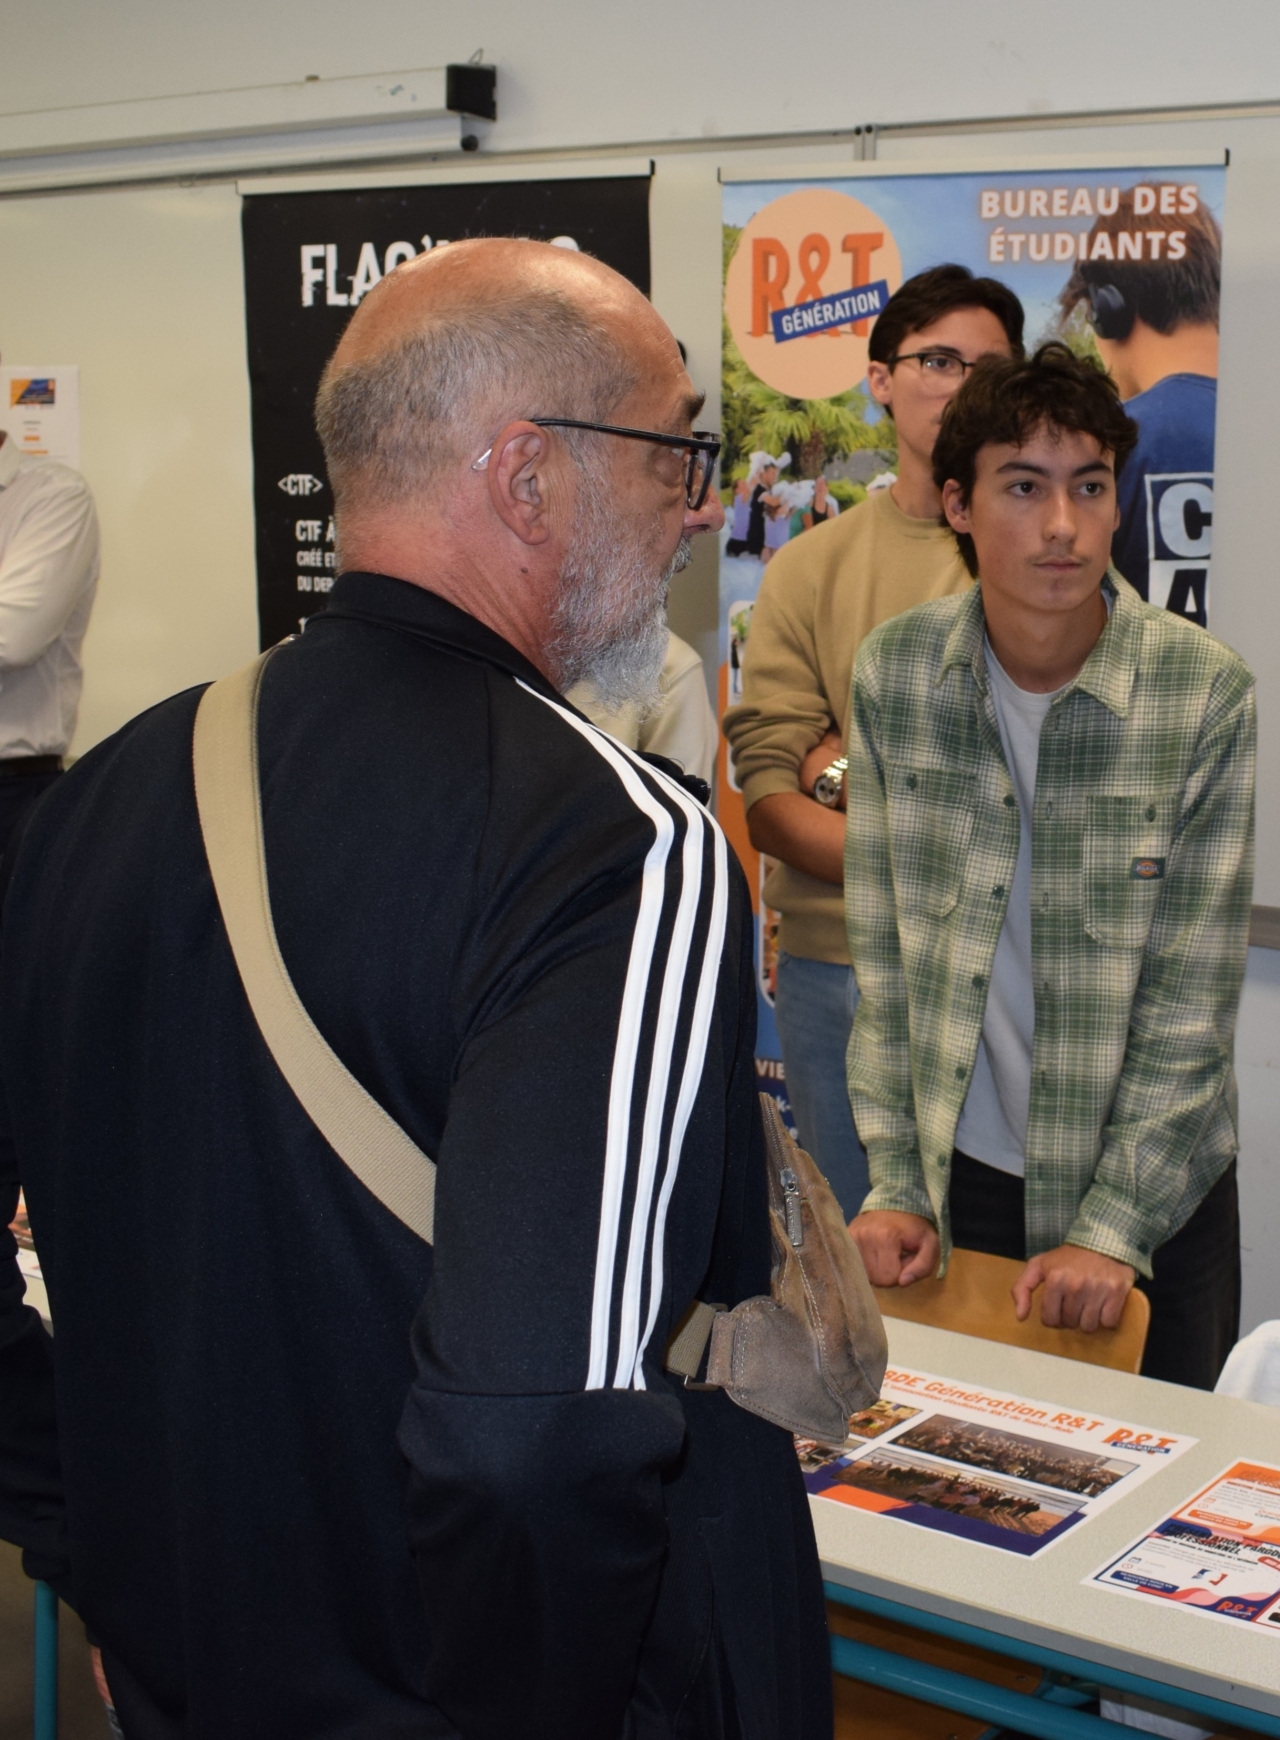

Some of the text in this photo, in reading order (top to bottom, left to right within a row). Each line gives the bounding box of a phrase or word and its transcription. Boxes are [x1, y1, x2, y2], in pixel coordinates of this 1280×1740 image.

[981, 185, 1198, 218] BUREAU DES
[989, 226, 1187, 262] ÉTUDIANTS
[751, 232, 884, 338] R&T
[781, 289, 881, 335] GÉNÉRATION
[295, 519, 322, 541] CTF
[296, 548, 322, 567] CRÉÉ
[297, 576, 312, 592] DU
[755, 1059, 785, 1080] VIE
[925, 1381, 1048, 1418] Génération
[1051, 1413, 1104, 1431] R&T
